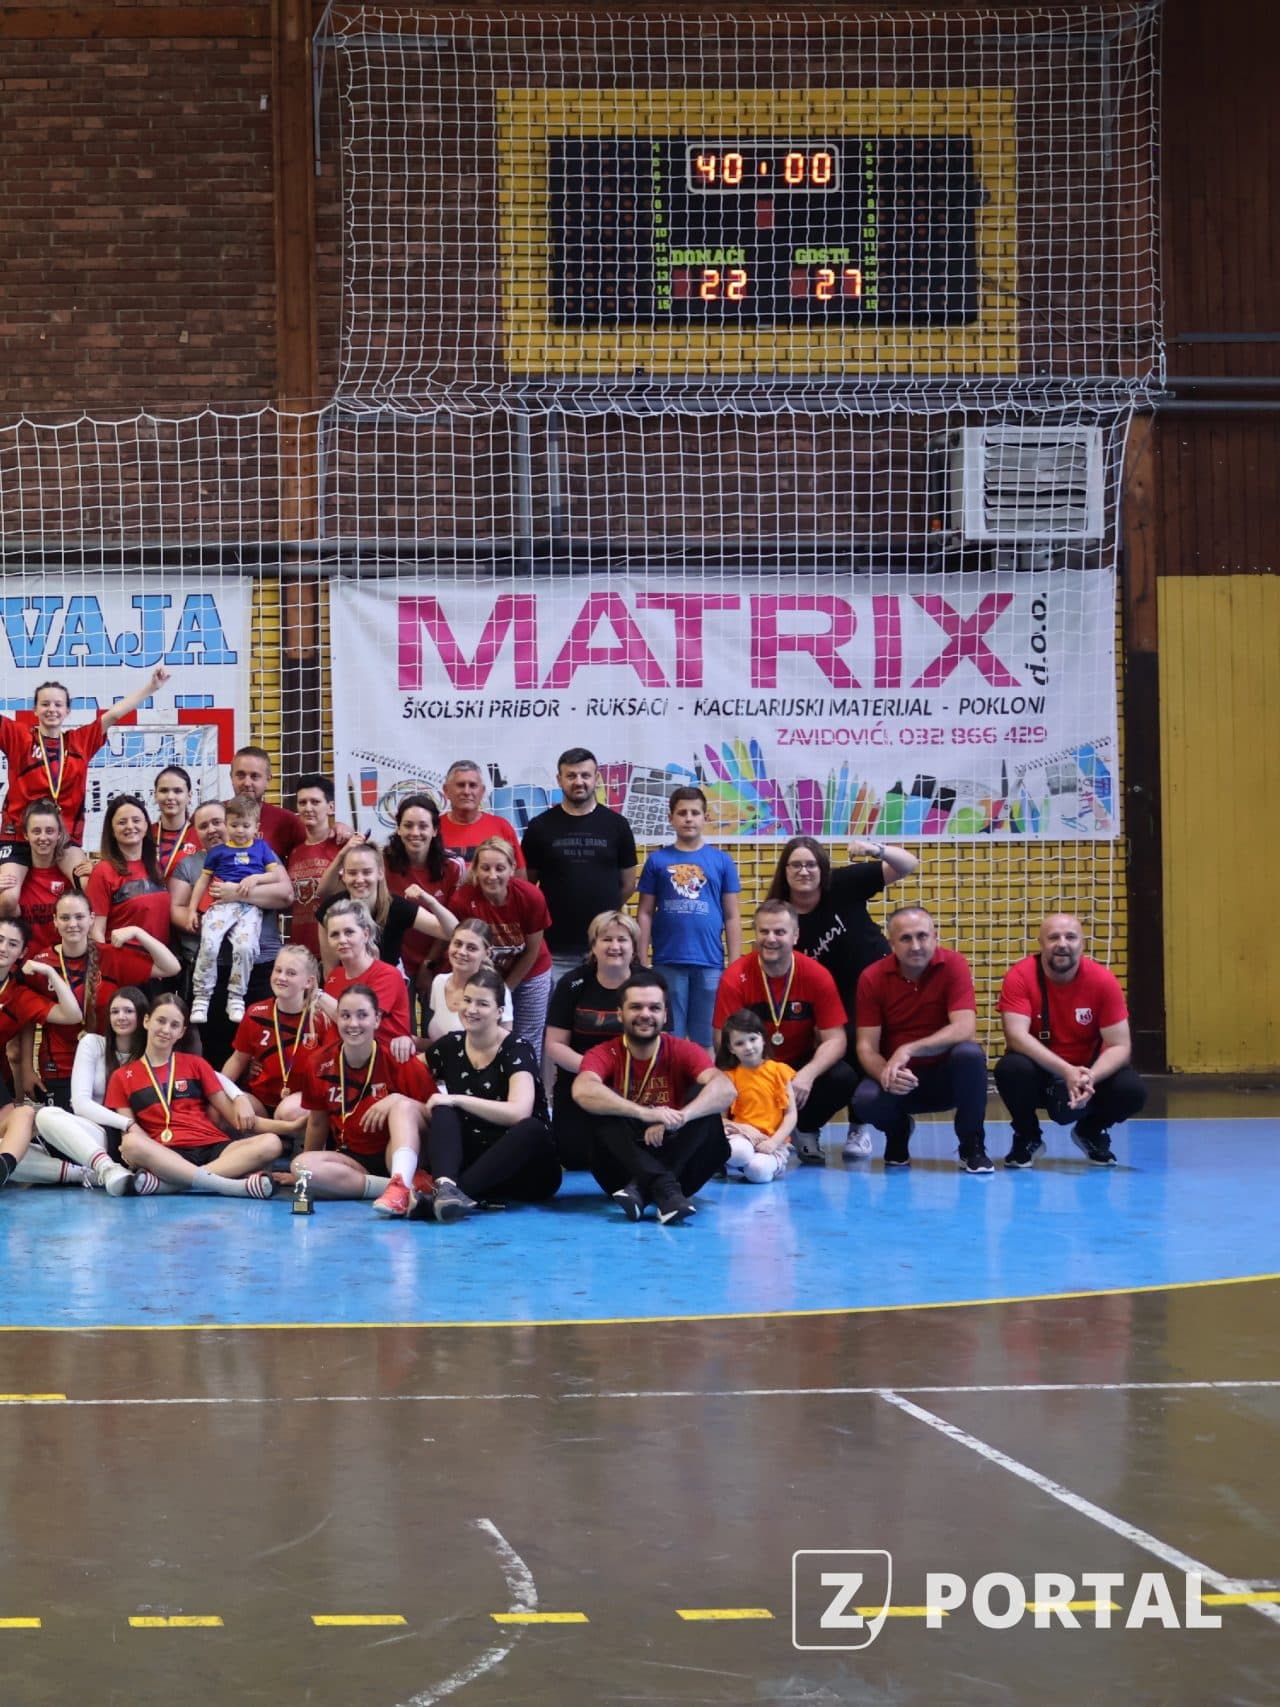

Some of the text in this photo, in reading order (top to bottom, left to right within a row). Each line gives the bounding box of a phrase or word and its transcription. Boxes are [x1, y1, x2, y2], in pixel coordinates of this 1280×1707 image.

[671, 246, 745, 265] DOMAĆI
[795, 248, 849, 265] GOSTI
[700, 269, 747, 299] 22
[816, 269, 861, 299] 27
[398, 592, 1022, 691] MATRIX
[402, 697, 484, 719] ŠKOLSKI
[489, 699, 561, 718] PRIBOR
[586, 697, 669, 717] RUKSACI
[828, 697, 933, 717] MATERIJAL
[958, 696, 1046, 716] POKLONI
[804, 913, 847, 960] uper!
[260, 1030, 271, 1047] 2
